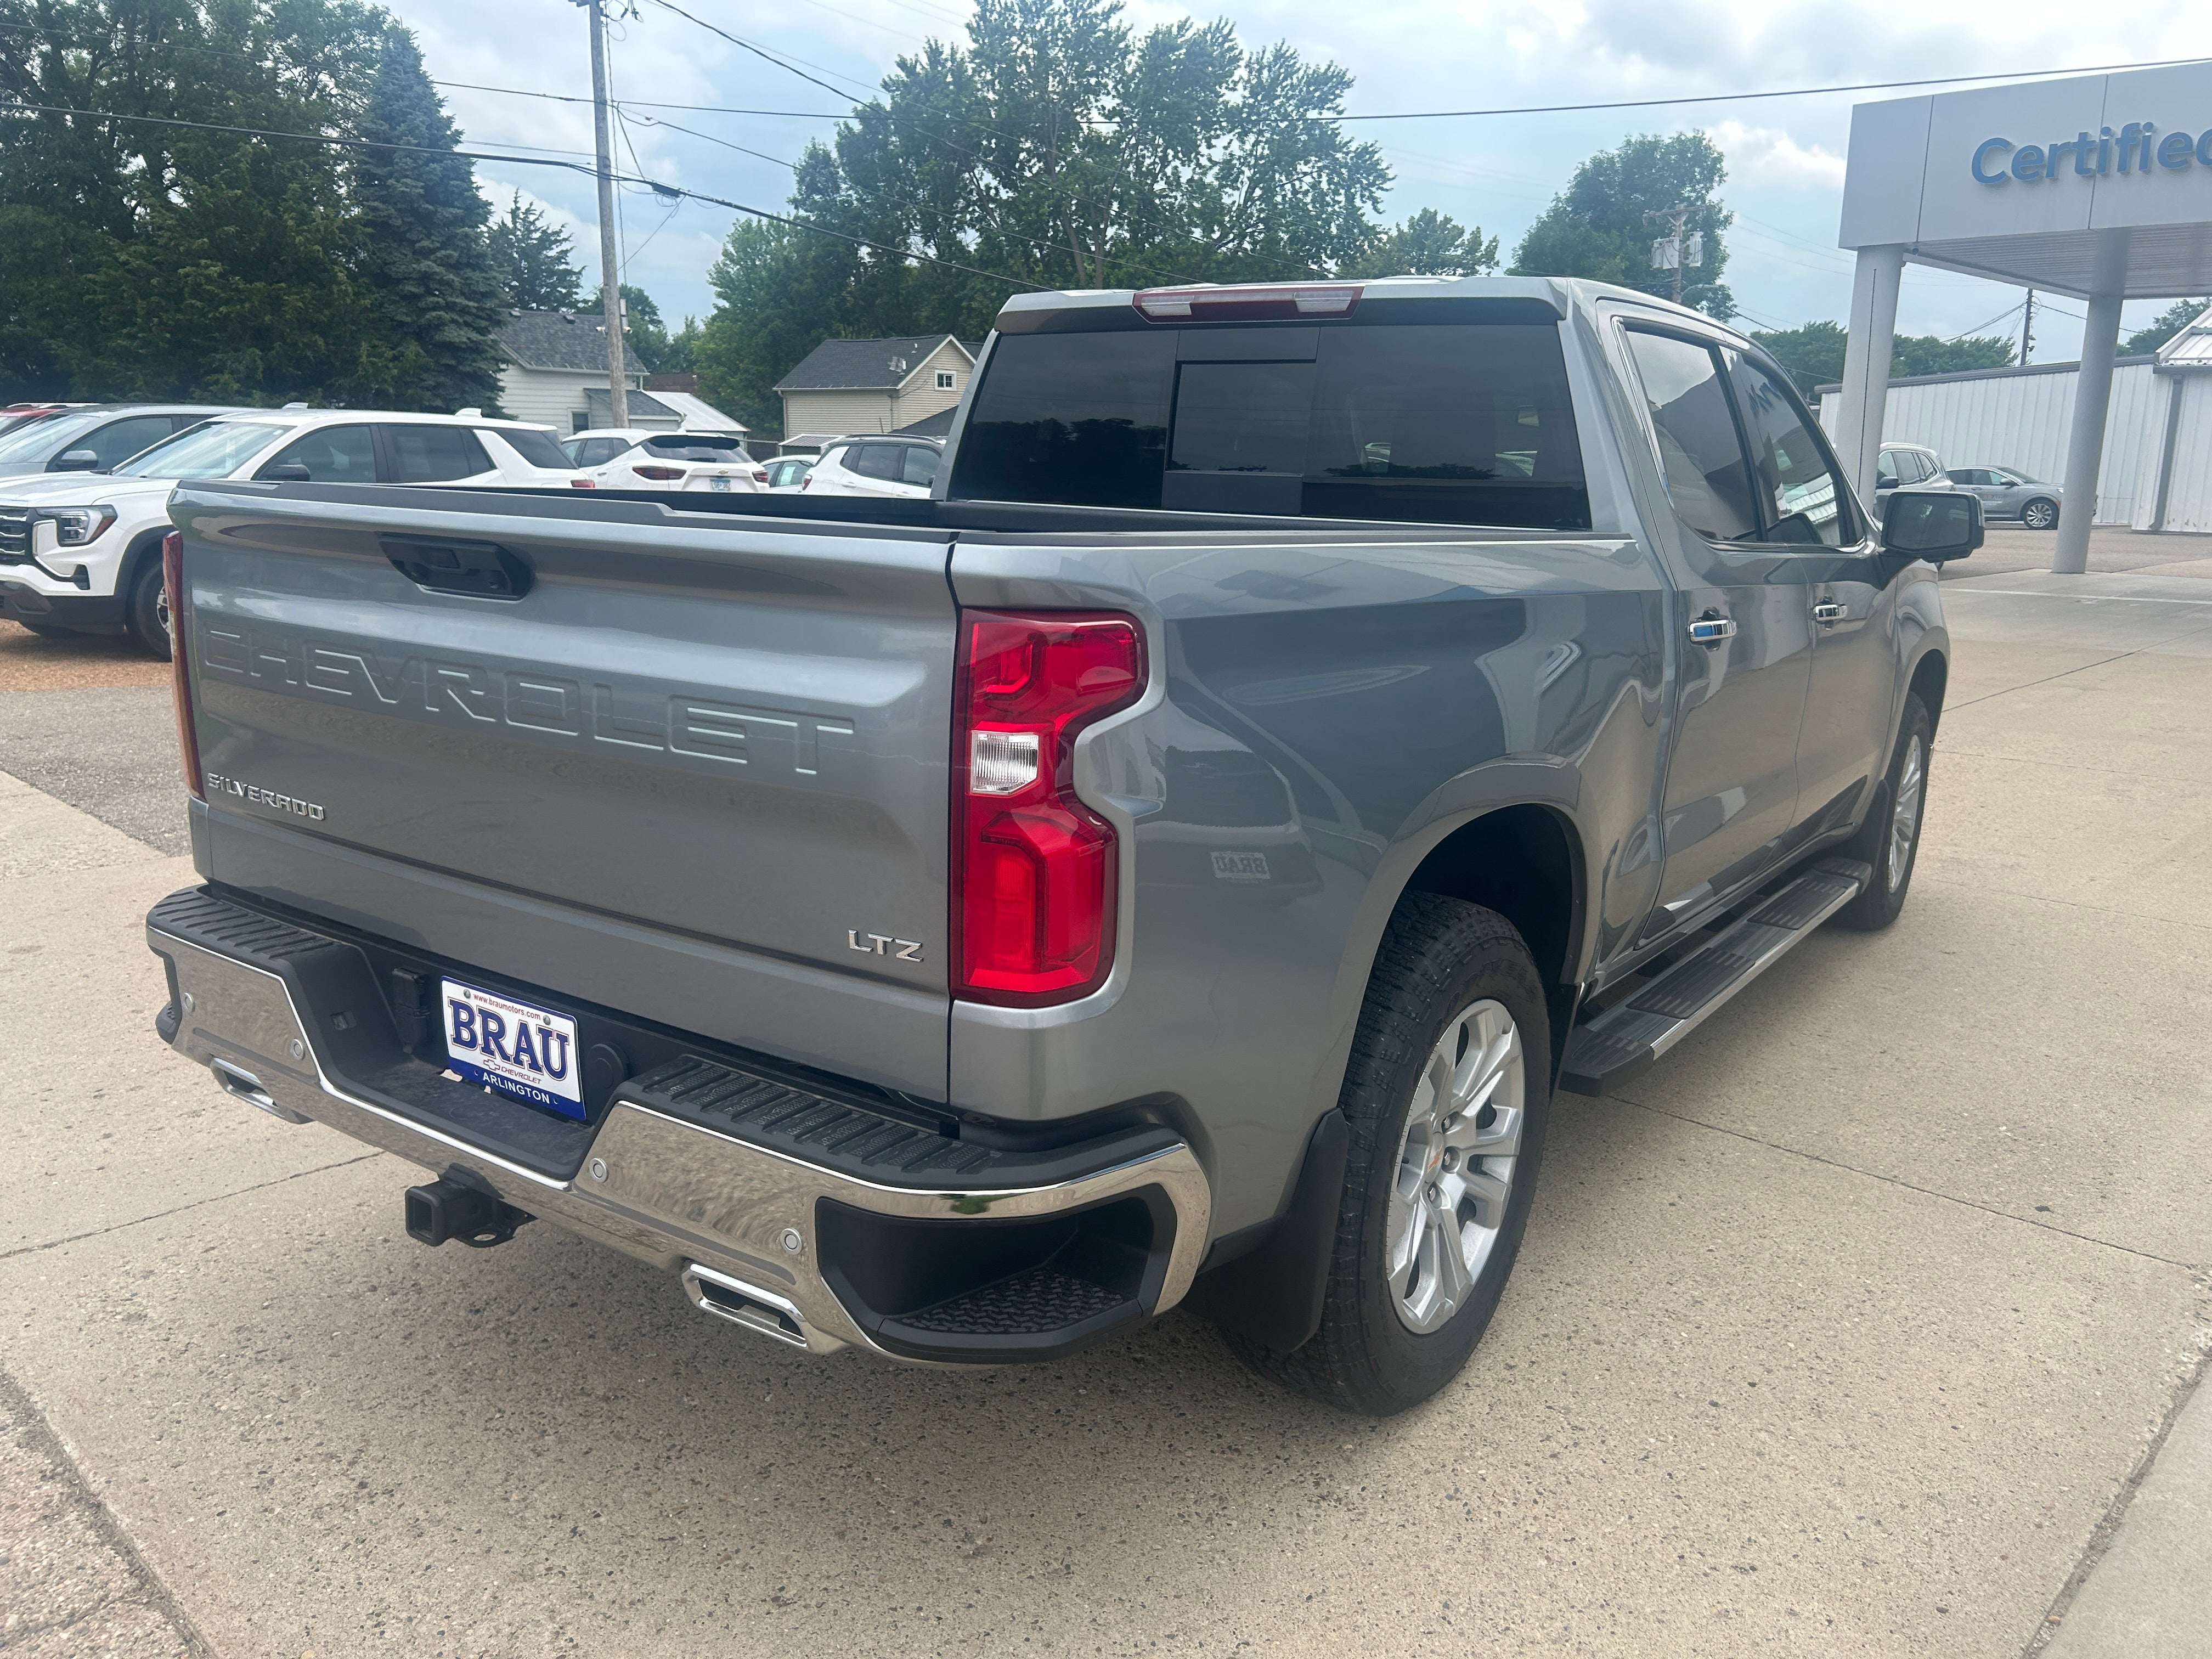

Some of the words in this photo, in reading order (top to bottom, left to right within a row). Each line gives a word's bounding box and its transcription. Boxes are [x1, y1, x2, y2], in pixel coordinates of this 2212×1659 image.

[205, 620, 854, 775] CHEVROLET
[207, 772, 326, 821] SILVERADO
[848, 929, 924, 962] LTZ
[473, 992, 541, 1021] www.braumotors.com
[447, 996, 570, 1081] BRAU
[482, 1071, 550, 1104] ARLINGTON
[501, 1065, 542, 1085] CHEVROLET
